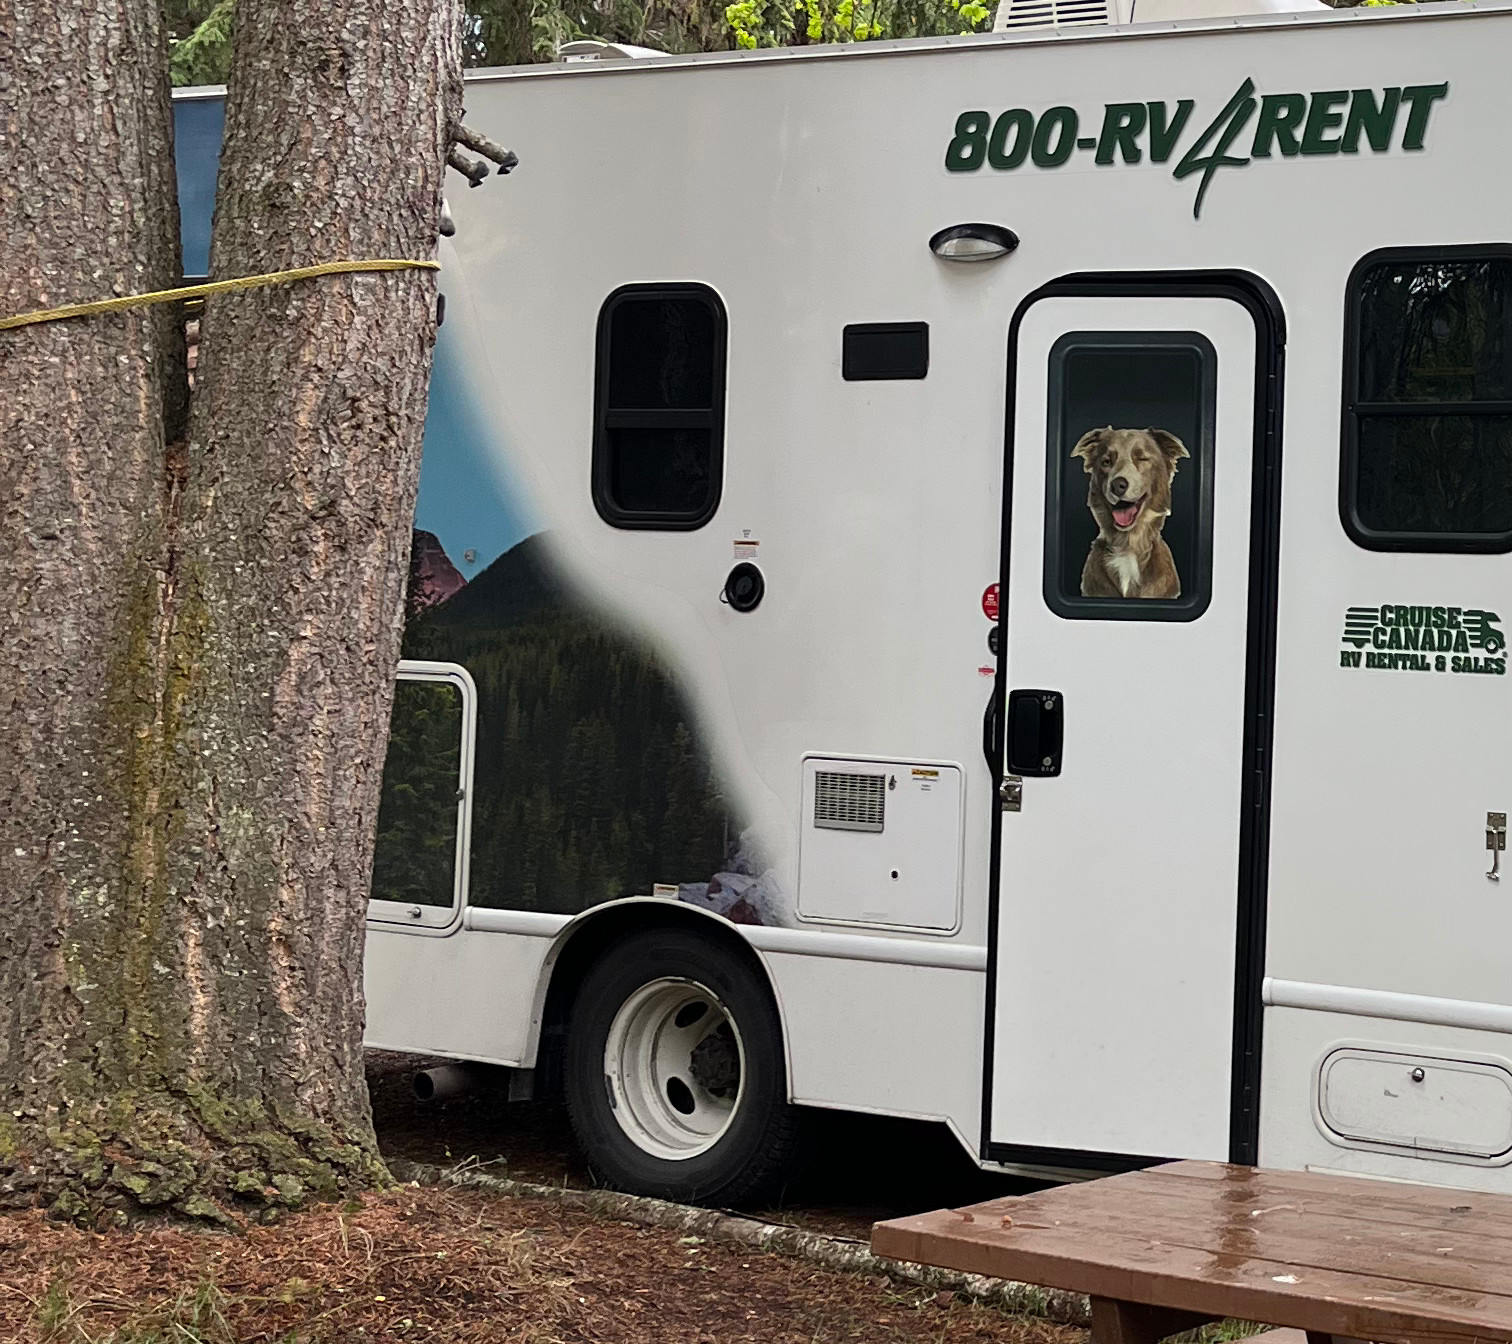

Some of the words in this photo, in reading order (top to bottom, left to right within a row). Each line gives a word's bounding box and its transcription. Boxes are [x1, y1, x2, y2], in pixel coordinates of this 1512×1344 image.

[1380, 605, 1462, 629] CRUISE
[1372, 627, 1469, 653] CANADA
[1340, 651, 1362, 668] RV
[1365, 652, 1430, 671] RENTAL
[1434, 655, 1446, 672] &
[1451, 656, 1506, 675] SALES
